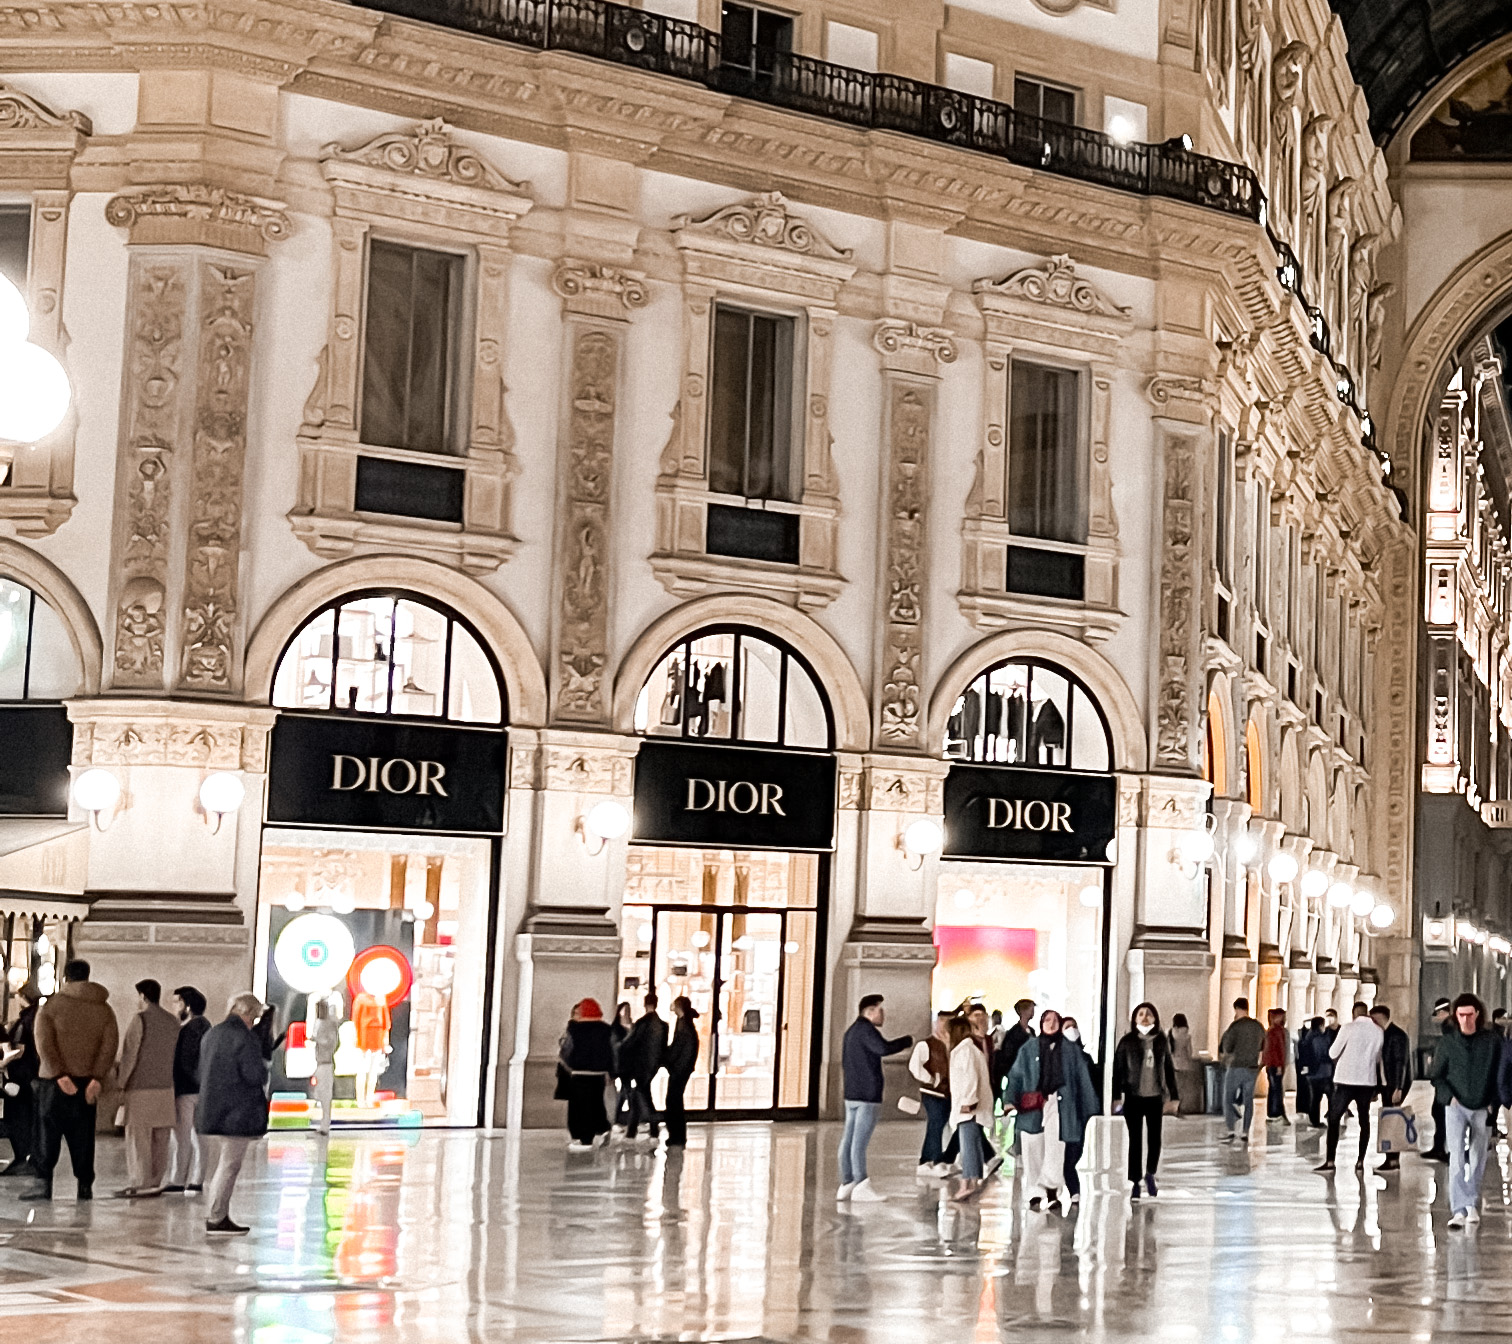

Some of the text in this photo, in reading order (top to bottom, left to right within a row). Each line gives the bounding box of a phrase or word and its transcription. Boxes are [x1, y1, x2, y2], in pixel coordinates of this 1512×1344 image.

[329, 754, 448, 797] DIOR
[684, 777, 787, 816] DIOR
[986, 797, 1075, 833] DIOR
